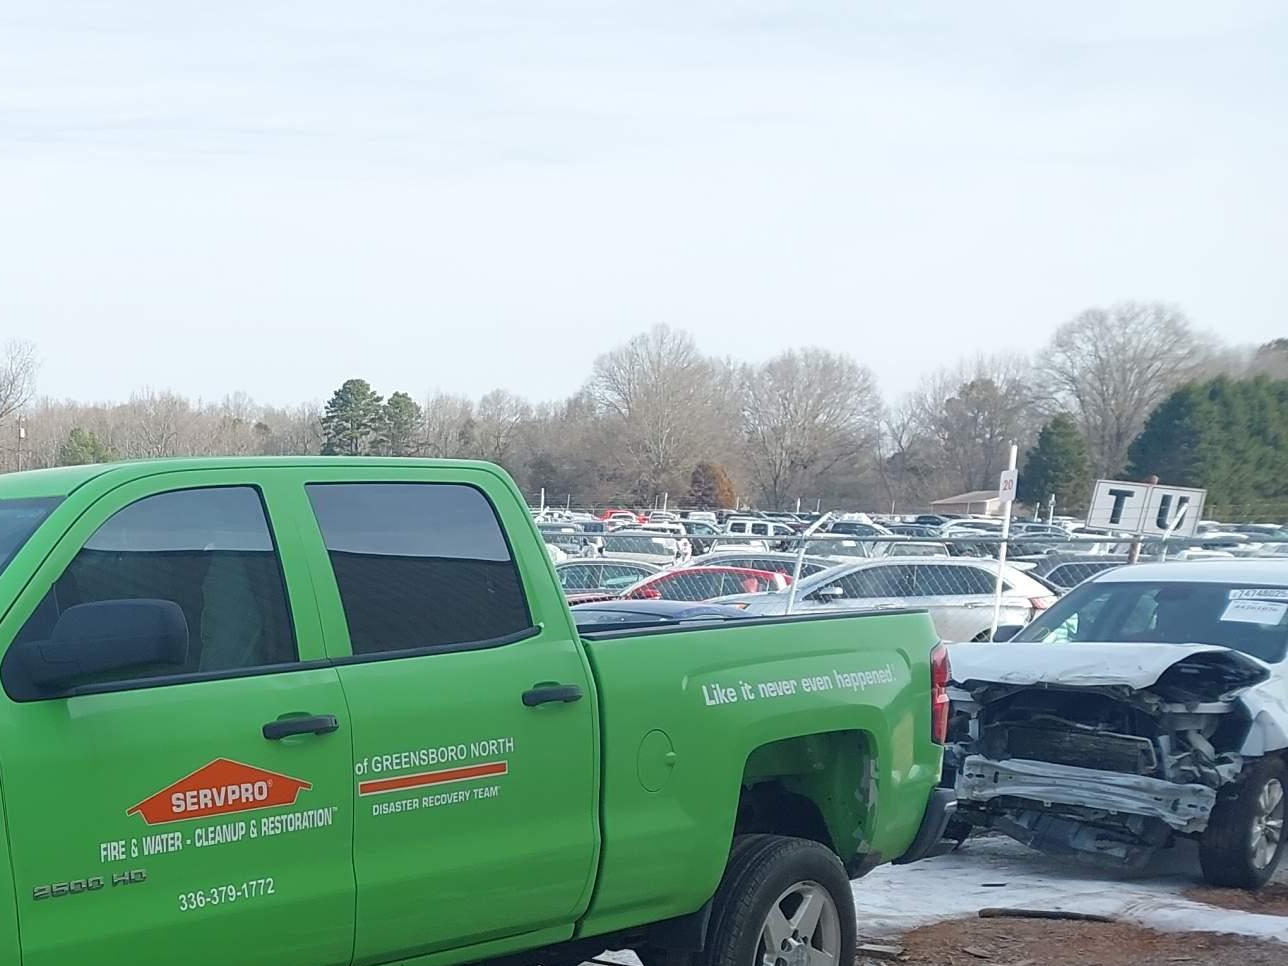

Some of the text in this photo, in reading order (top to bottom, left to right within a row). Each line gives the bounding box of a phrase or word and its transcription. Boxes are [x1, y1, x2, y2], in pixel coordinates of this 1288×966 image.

[1003, 479, 1014, 491] 20
[1108, 488, 1190, 531] T U
[702, 682, 737, 706] Like
[739, 680, 755, 701] it
[758, 680, 797, 698] never
[802, 675, 833, 693] even
[355, 737, 514, 775] of GREENSBORO NORTH
[373, 798, 419, 816] DISASTER
[422, 789, 470, 808] RECOVERY
[100, 841, 126, 863] FIRE
[131, 839, 139, 858] &
[142, 831, 183, 856] WATER
[195, 822, 246, 847] CLEANUP
[250, 819, 257, 838] &
[33, 869, 147, 900] 2500 HD
[178, 877, 275, 911] 336-379-1772
